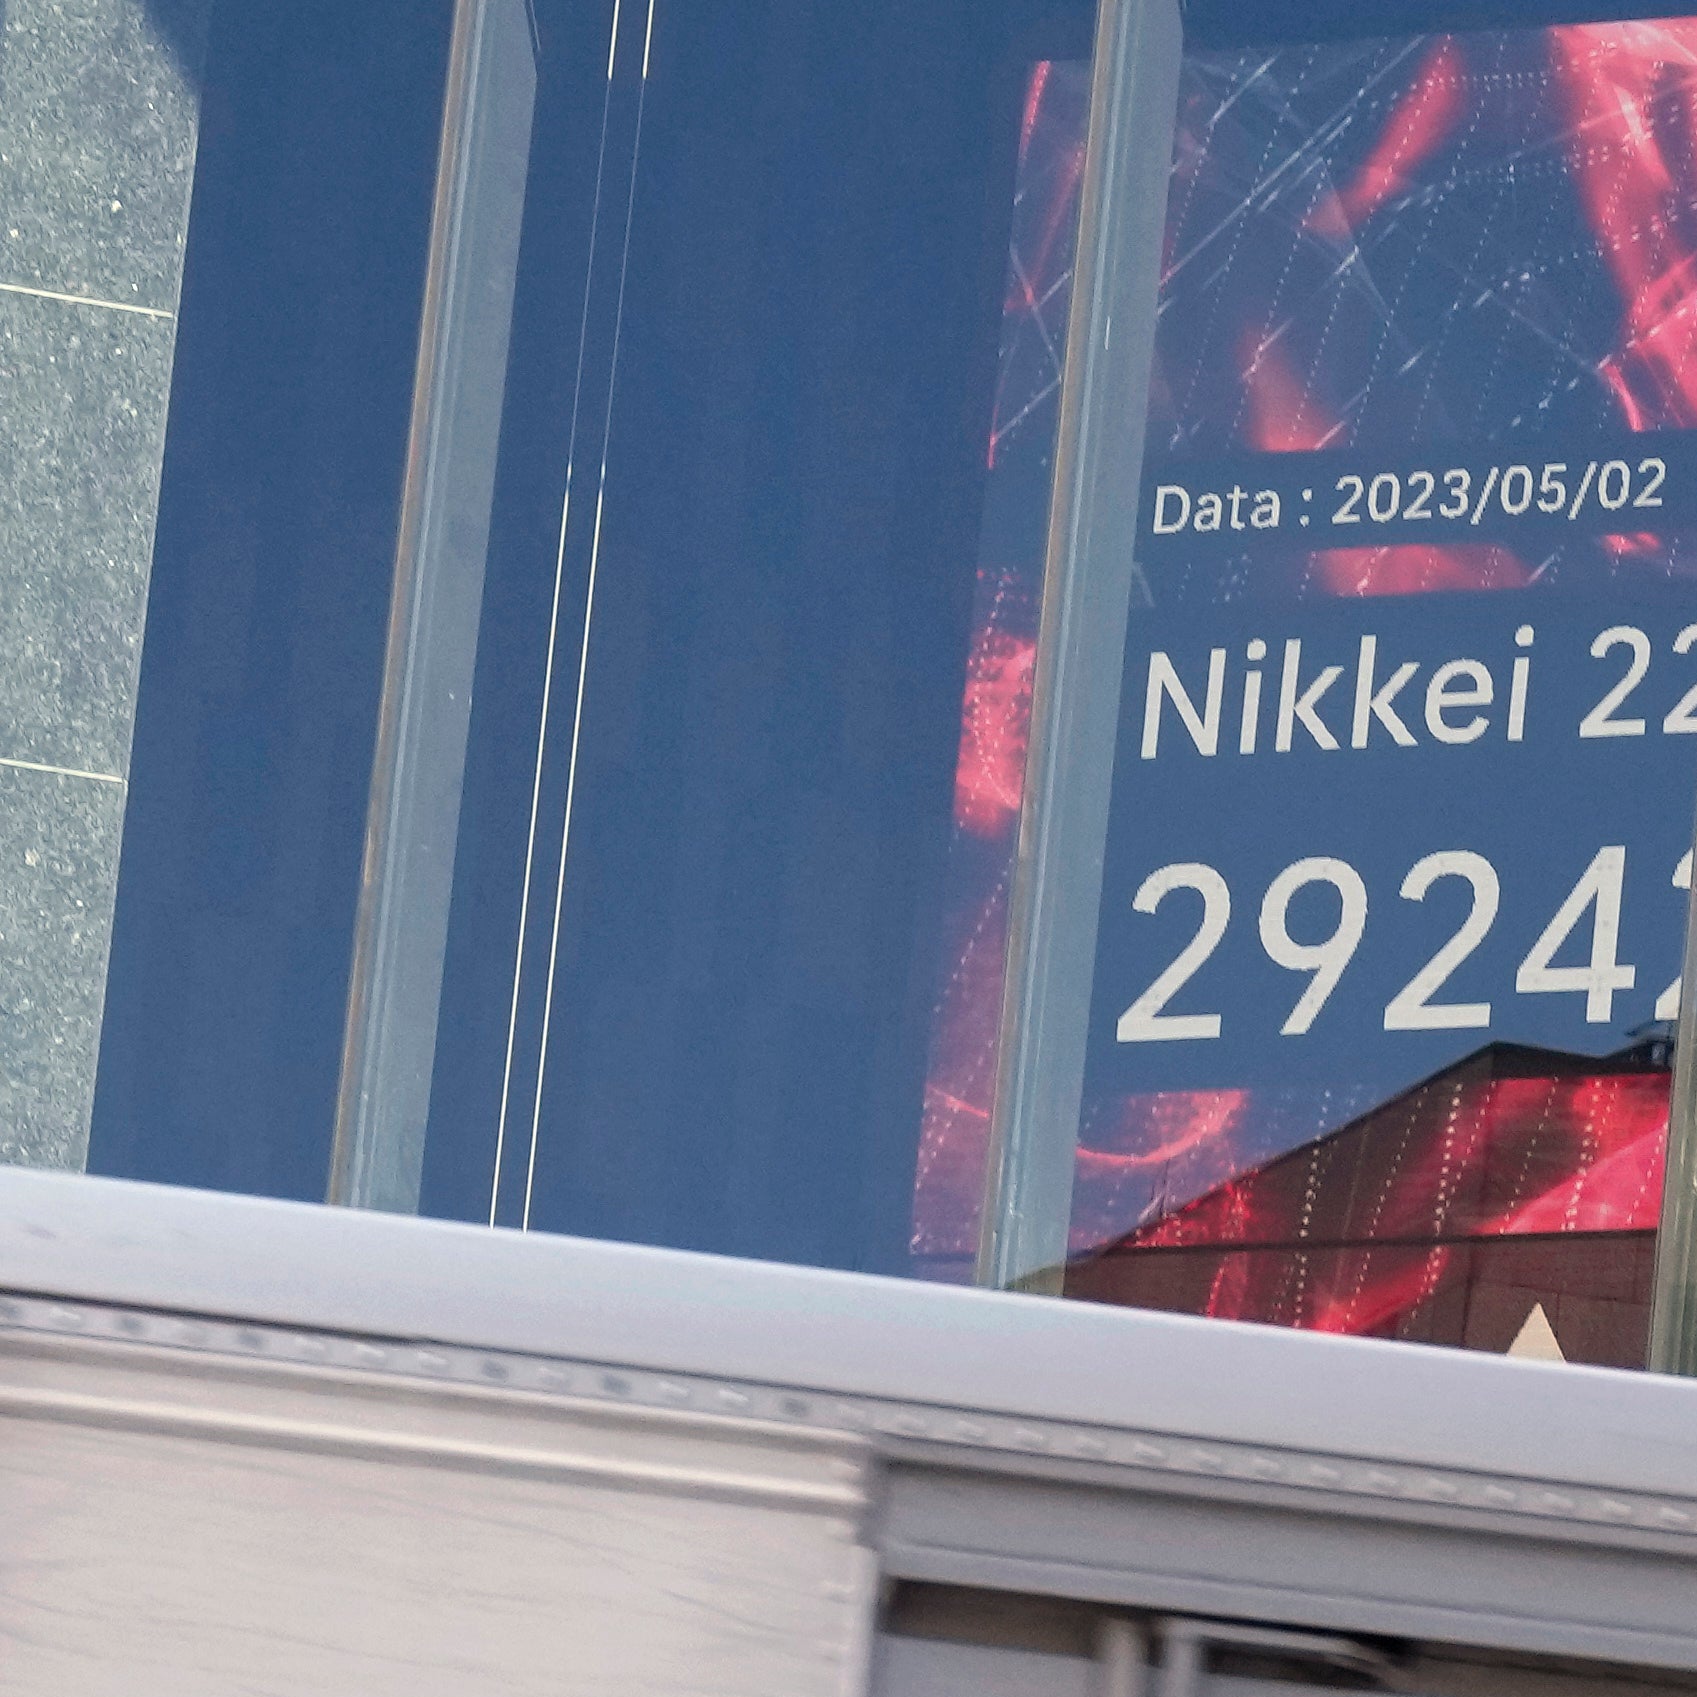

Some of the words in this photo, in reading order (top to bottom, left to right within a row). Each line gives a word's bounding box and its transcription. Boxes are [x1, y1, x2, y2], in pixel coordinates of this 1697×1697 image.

[1152, 482, 1281, 534] Data
[1332, 456, 1667, 527] 2023/05/02
[1141, 623, 1535, 760] Nikkei
